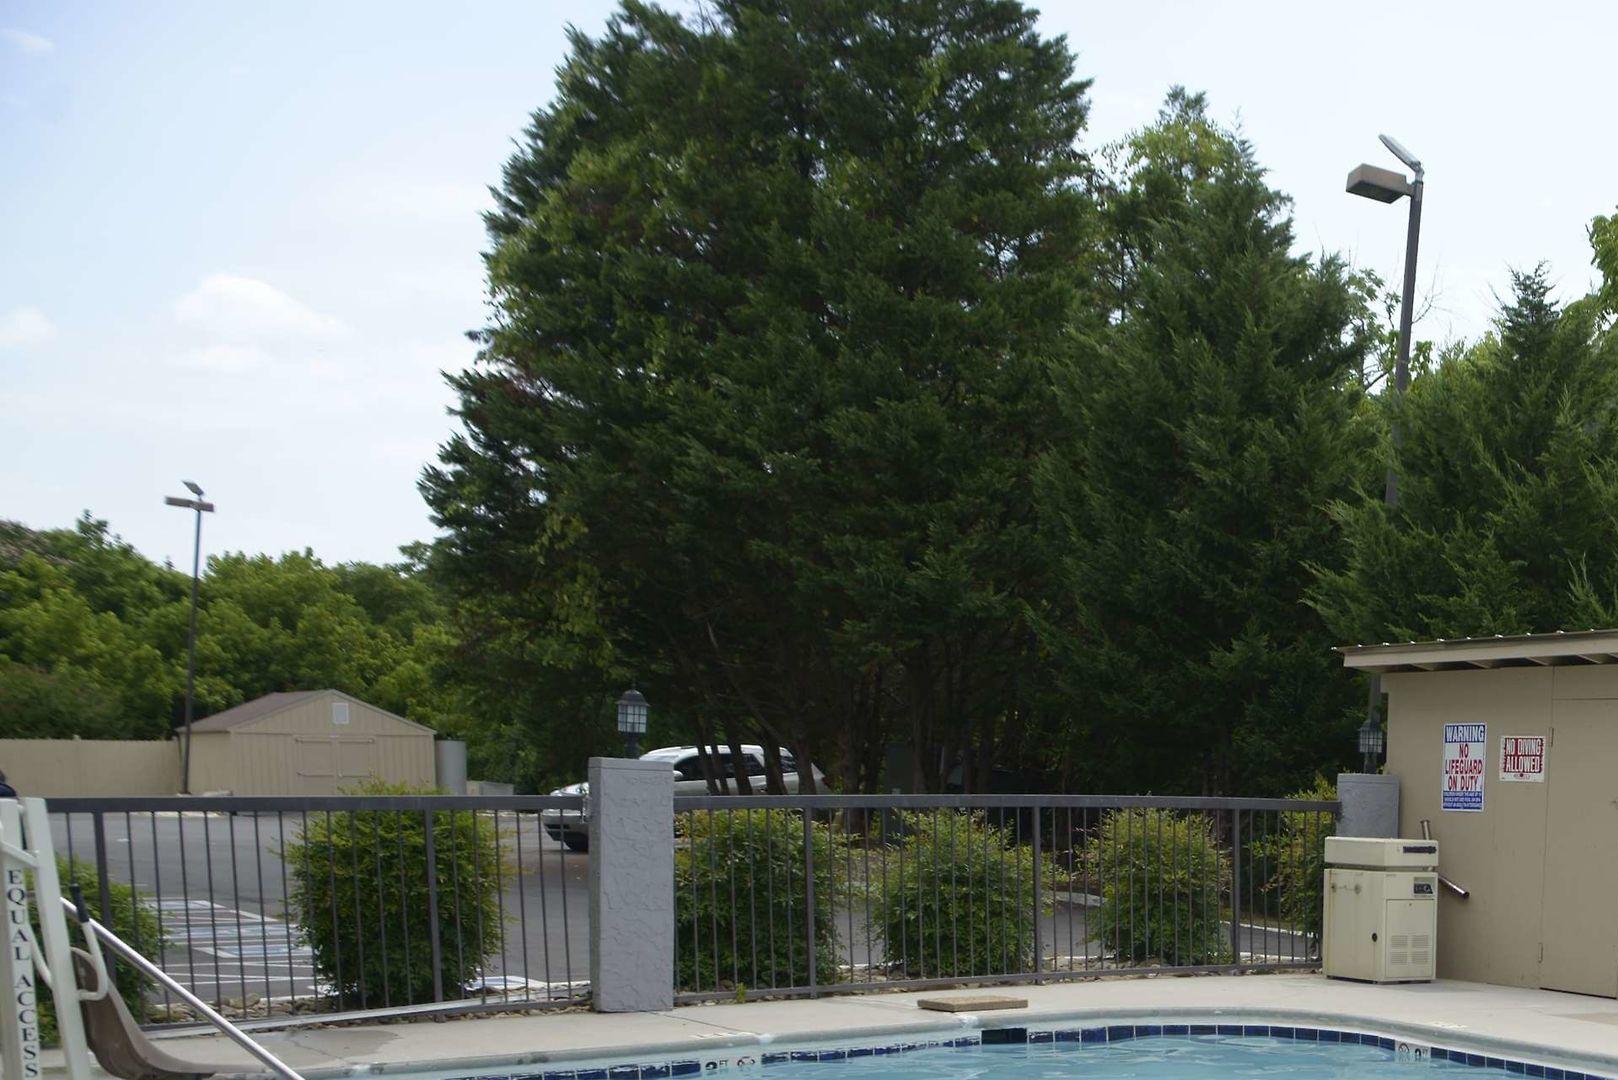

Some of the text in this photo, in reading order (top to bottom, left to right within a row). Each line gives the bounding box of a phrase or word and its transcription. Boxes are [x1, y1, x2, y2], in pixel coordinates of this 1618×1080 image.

[1446, 726, 1485, 742] WARNING
[1459, 743, 1469, 759] NO
[1506, 738, 1541, 755] NO DIVING
[1445, 759, 1482, 775] LIFEGUARD
[1505, 756, 1541, 772] ALLOWED
[1448, 775, 1478, 791] ON DUTY
[6, 869, 39, 1079] EQUAL ACCESS
